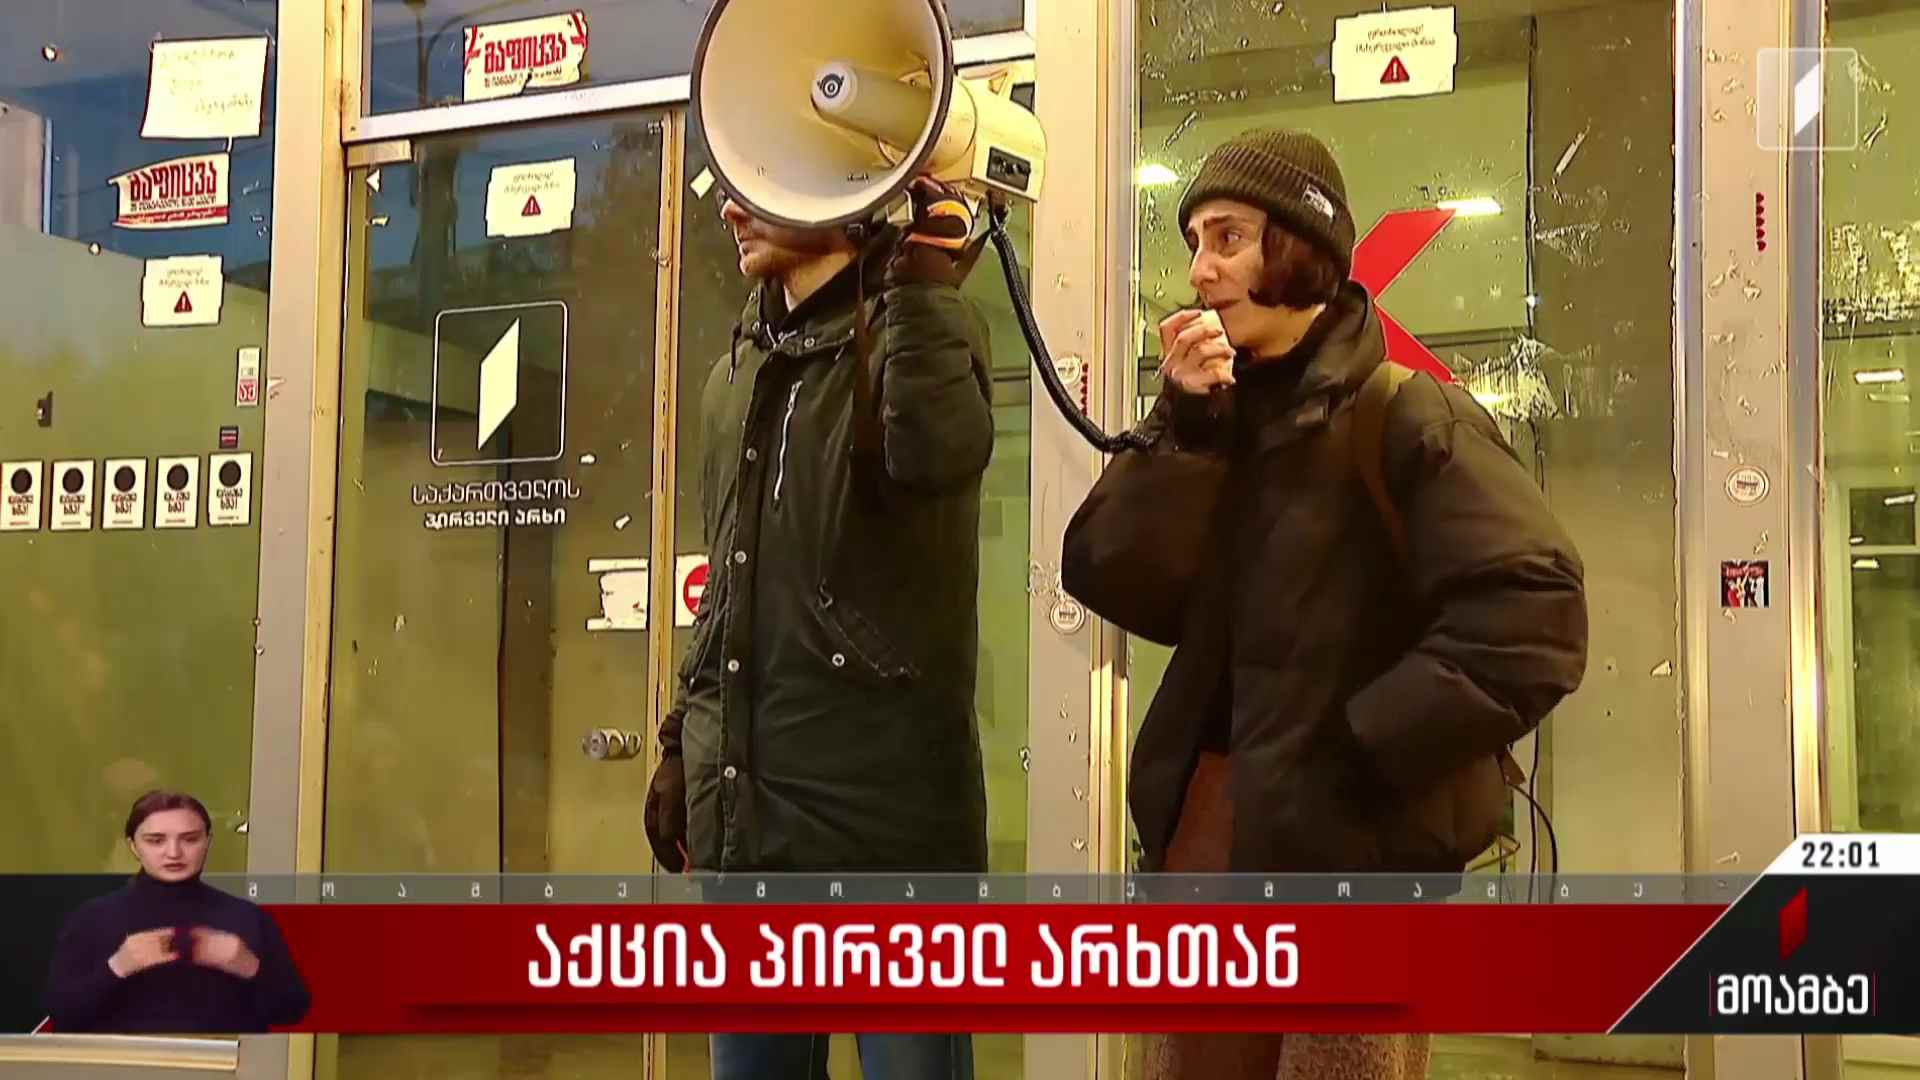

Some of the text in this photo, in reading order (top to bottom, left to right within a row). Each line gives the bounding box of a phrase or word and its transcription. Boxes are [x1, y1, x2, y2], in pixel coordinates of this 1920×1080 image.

[411, 478, 581, 506] საქართველოს
[424, 507, 567, 530] პირველი არხი
